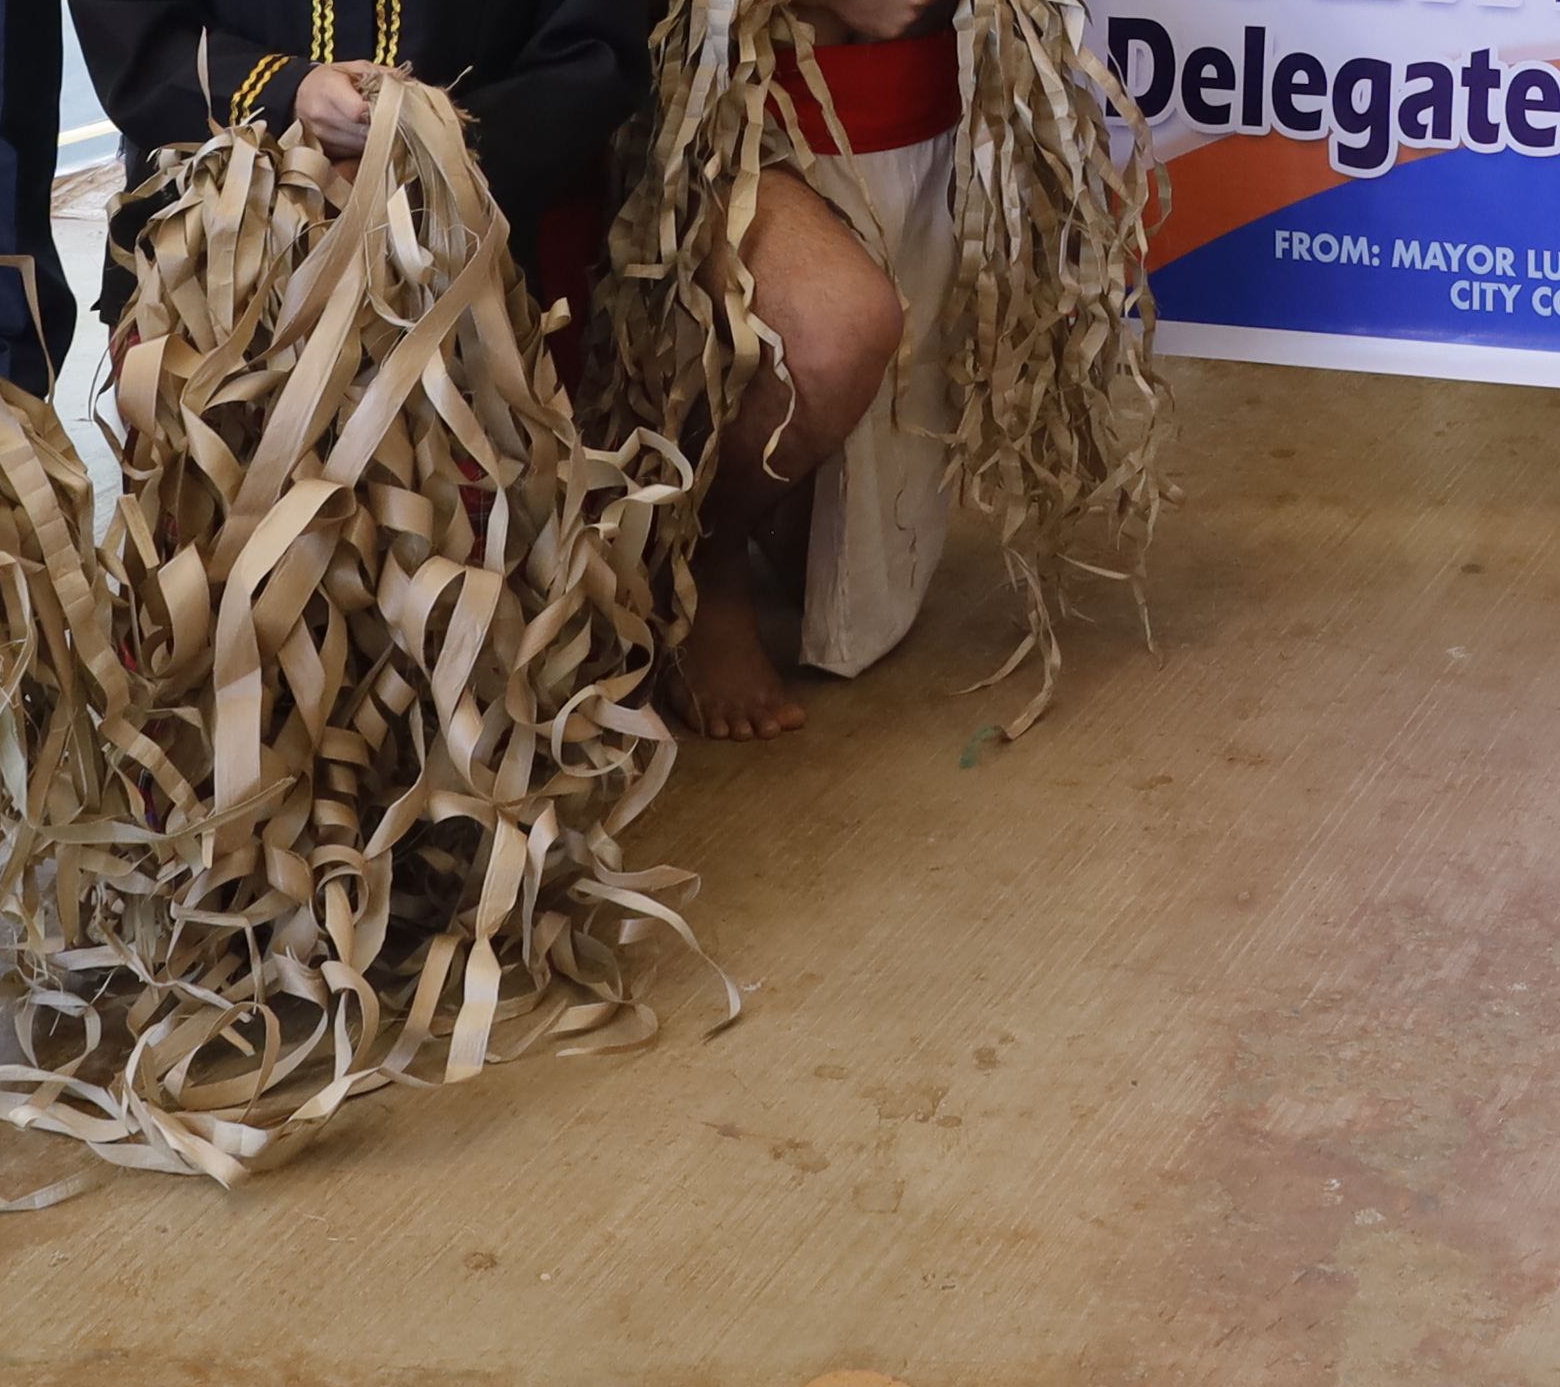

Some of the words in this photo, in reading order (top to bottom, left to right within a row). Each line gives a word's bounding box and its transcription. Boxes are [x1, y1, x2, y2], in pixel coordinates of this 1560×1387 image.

[1274, 229, 1381, 267] FROM:
[1392, 238, 1517, 278] MAYOR
[1449, 279, 1523, 313] CITY
